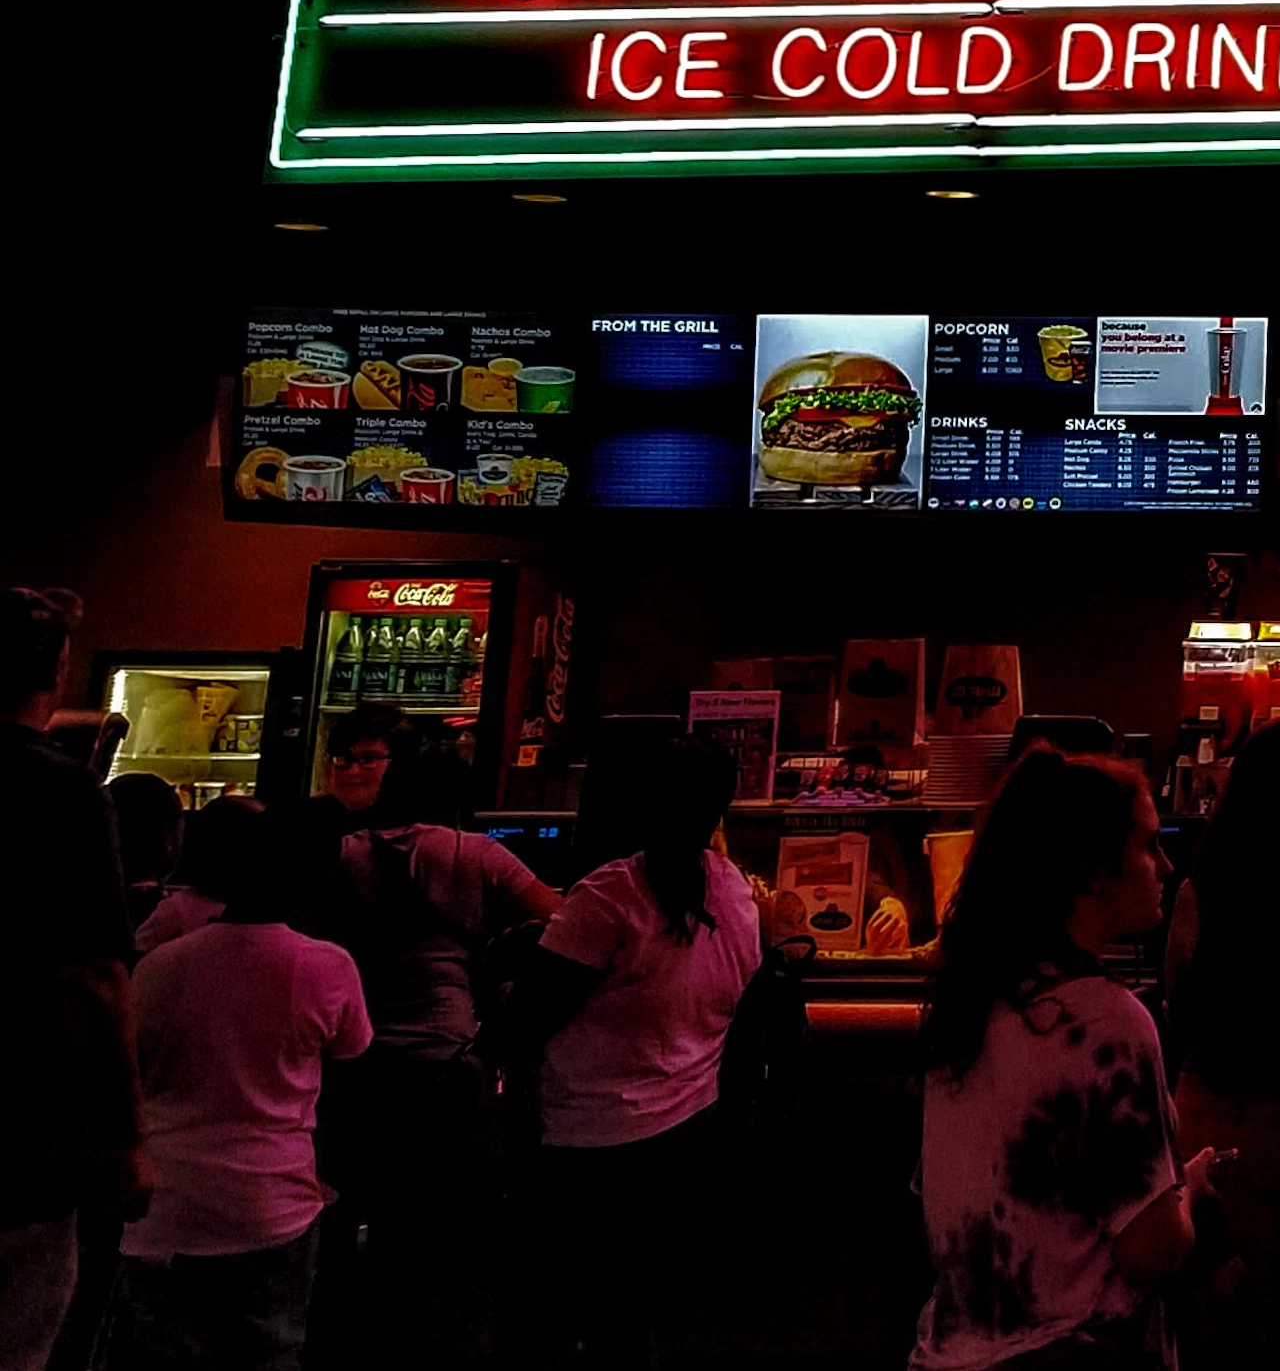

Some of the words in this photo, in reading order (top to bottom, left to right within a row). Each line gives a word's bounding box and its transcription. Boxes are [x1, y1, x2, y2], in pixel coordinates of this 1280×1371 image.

[585, 30, 729, 101] ICE
[771, 26, 1013, 100] COLD
[294, 323, 332, 334] Combo
[359, 324, 378, 335] Hot
[379, 325, 404, 337] Dog
[406, 325, 444, 336] Combo
[591, 320, 637, 332] FROM
[640, 320, 671, 333] THE
[674, 320, 718, 333] GRILL
[934, 323, 1010, 335] POPCORN
[1102, 322, 1146, 330] because
[512, 327, 551, 337] Combo
[1101, 334, 1122, 342] you
[1125, 333, 1161, 342] belong
[1137, 345, 1186, 353] premiere
[243, 414, 281, 426] Pretzel
[283, 415, 321, 426] Combo
[355, 417, 386, 428] Triple
[388, 417, 427, 428] Combo
[467, 419, 494, 430] Kid's
[496, 420, 534, 430] Combo
[930, 416, 988, 428] DRINKS
[1065, 419, 1127, 431] SNACKS
